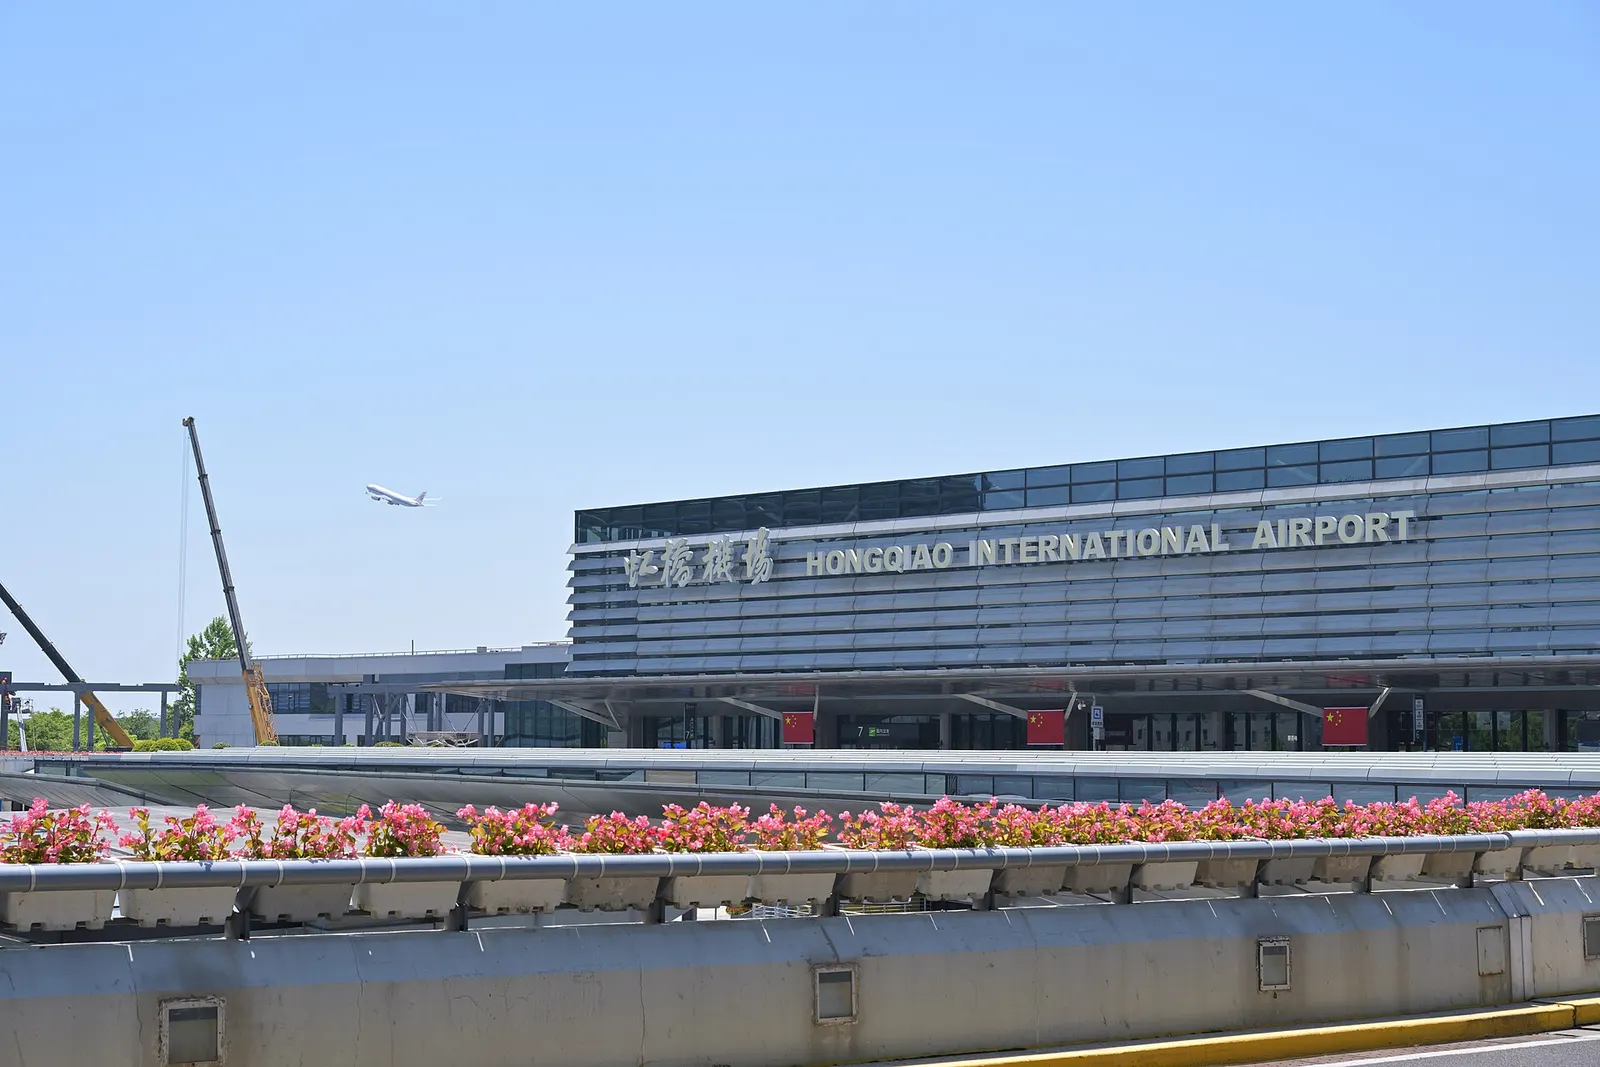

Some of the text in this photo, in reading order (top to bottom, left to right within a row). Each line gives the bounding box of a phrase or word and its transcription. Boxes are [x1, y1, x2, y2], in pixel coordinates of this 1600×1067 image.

[806, 510, 1416, 575] HONGQIAO INTERNATIONAL AIRPORT
[857, 726, 863, 737] 7
